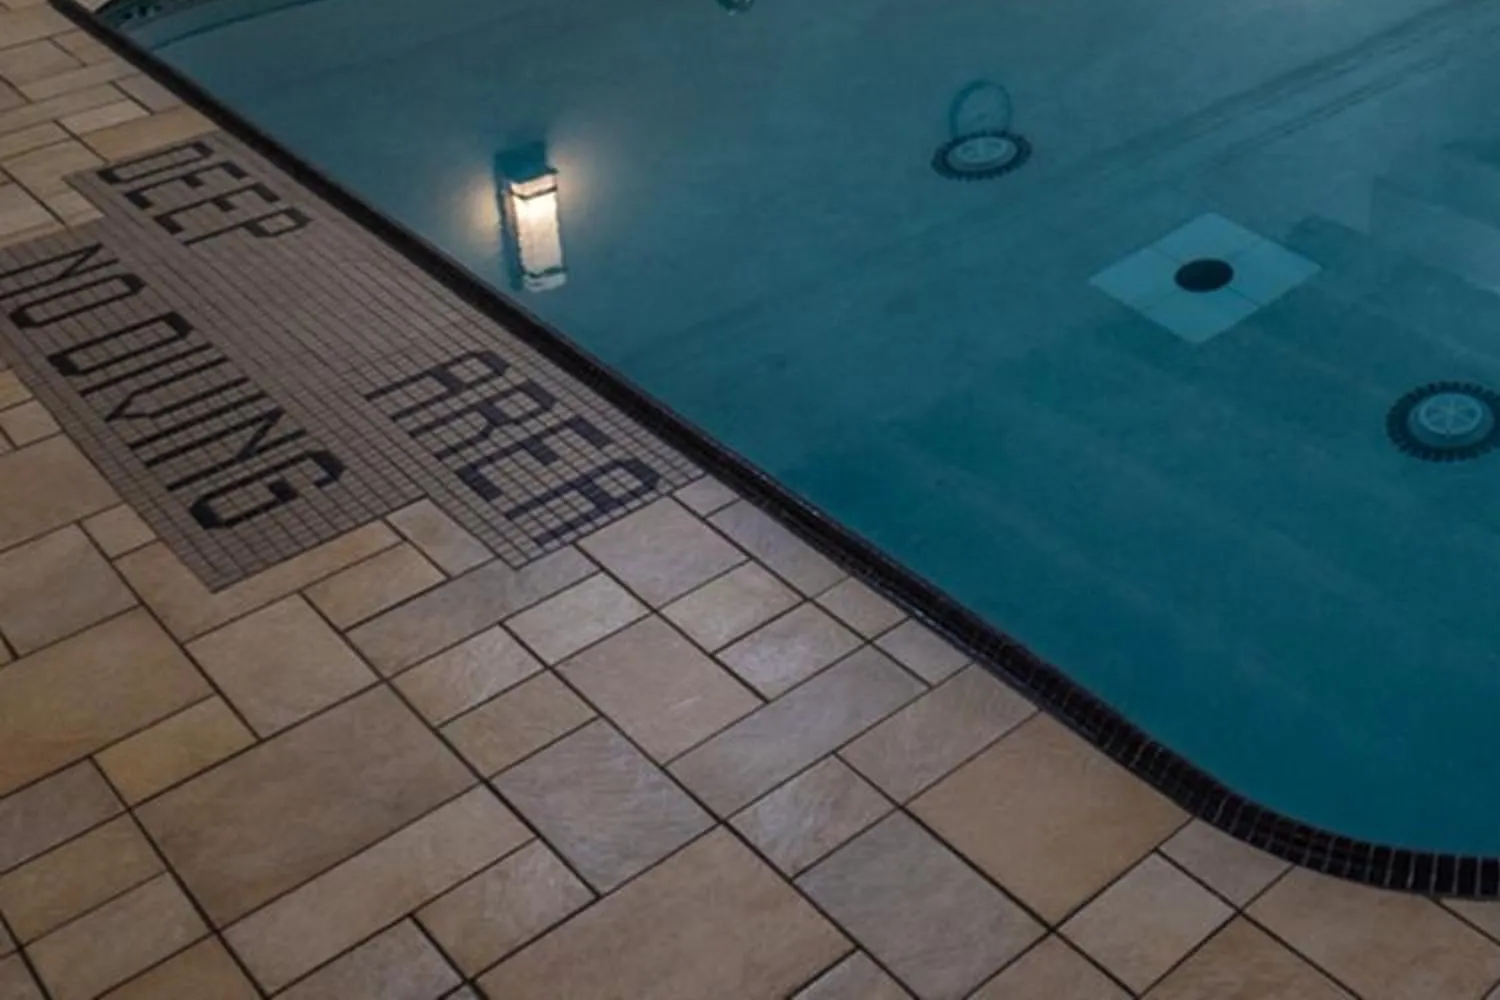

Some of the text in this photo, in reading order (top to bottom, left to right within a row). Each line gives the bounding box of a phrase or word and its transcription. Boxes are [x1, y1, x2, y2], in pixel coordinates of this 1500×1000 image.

[0, 243, 346, 531] NO DIVING
[98, 141, 661, 547] DEEP AREA
